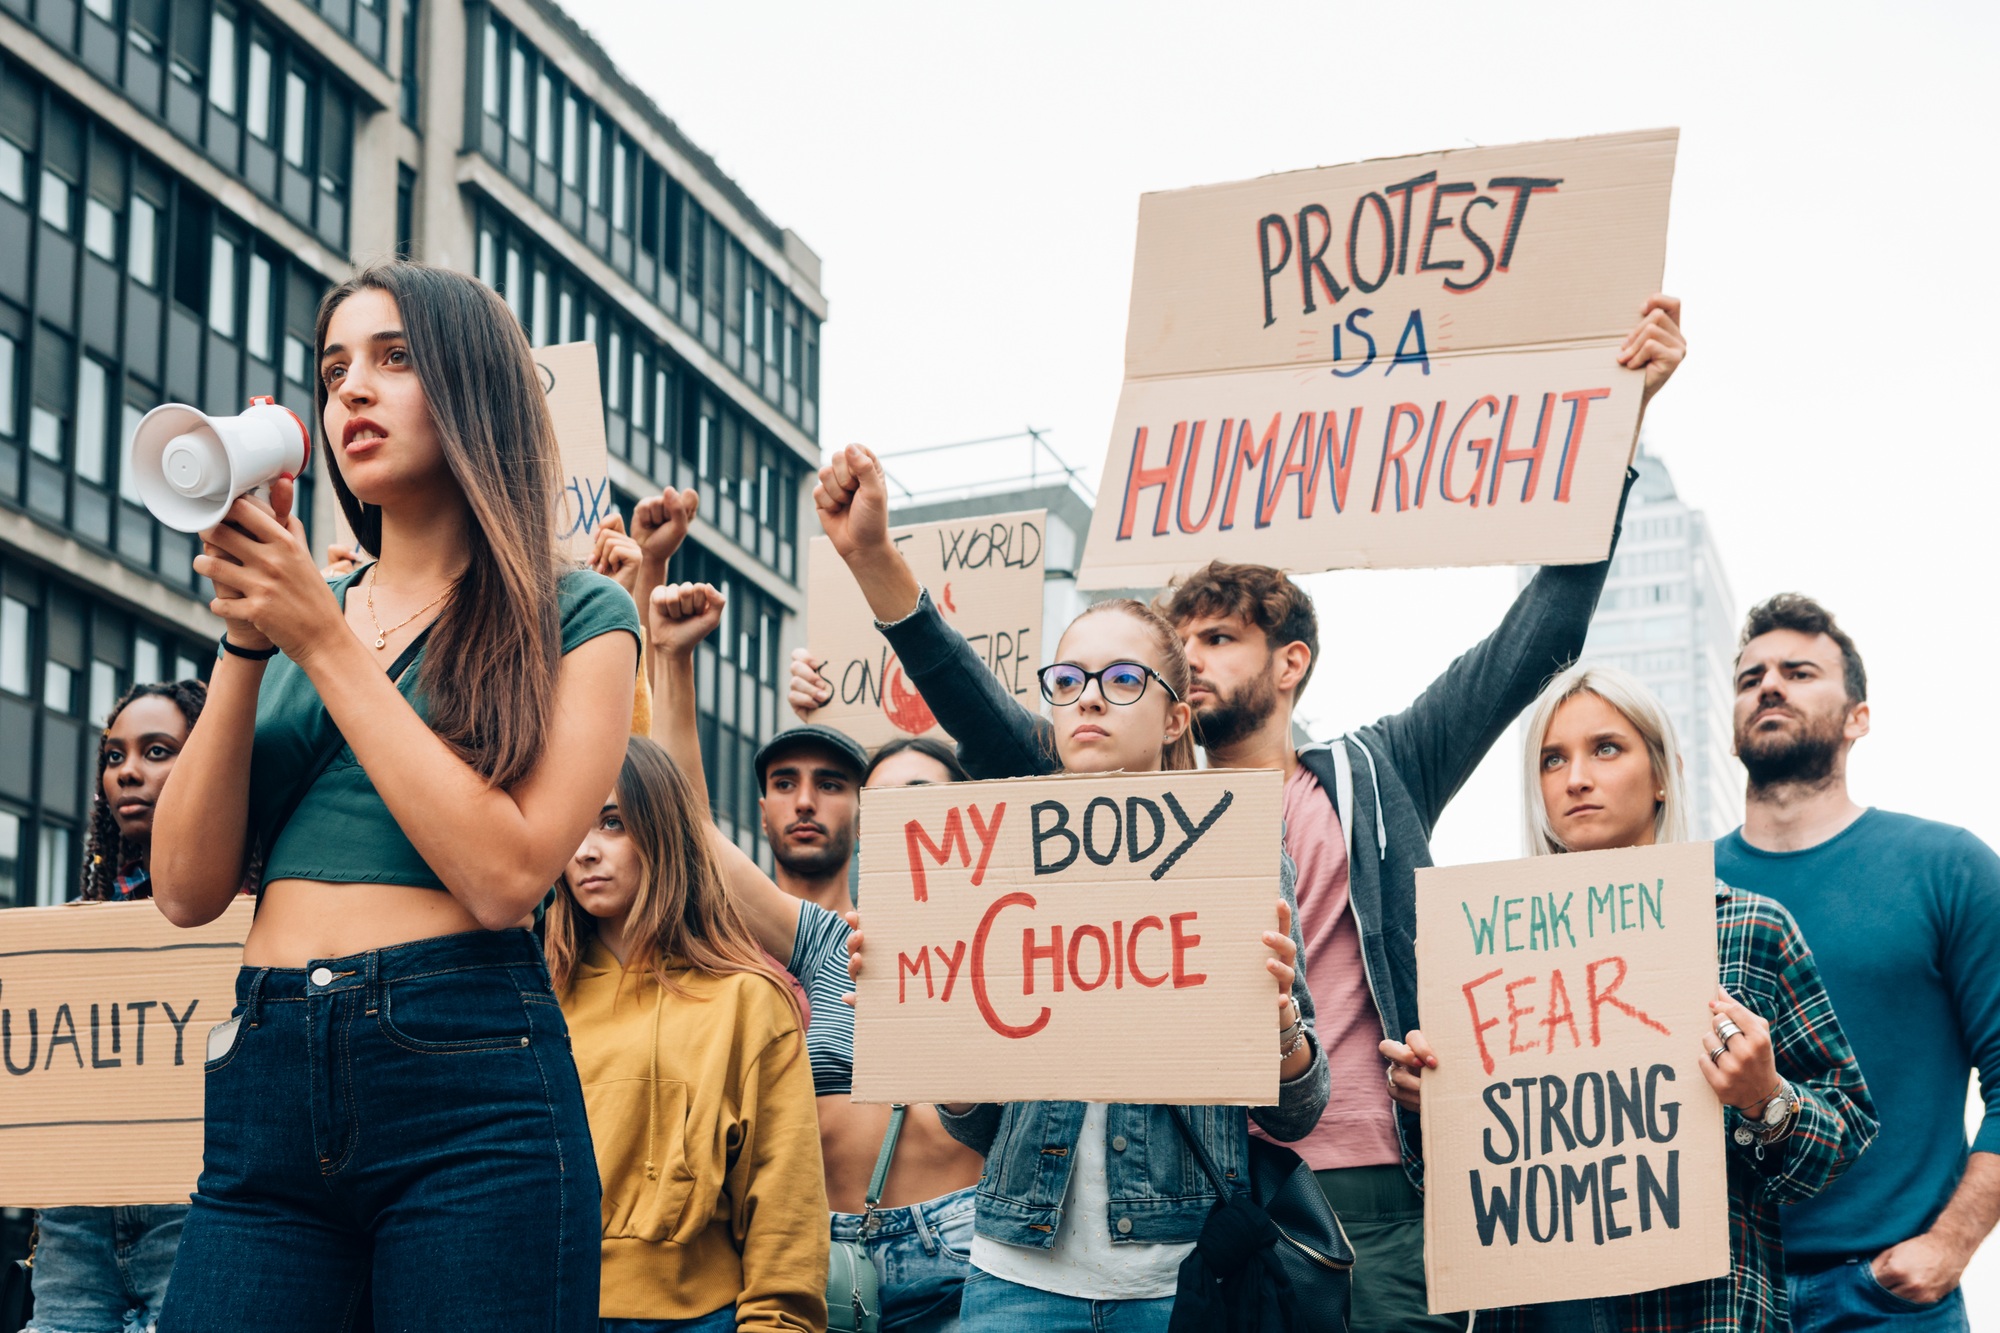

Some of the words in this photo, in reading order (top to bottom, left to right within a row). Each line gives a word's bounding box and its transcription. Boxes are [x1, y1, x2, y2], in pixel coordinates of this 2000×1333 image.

[1257, 171, 1564, 328] PROTEST
[1331, 308, 1377, 377] IS
[1384, 309, 1431, 376] A
[1115, 406, 1363, 541] HUMAN
[1371, 387, 1611, 513] RIGHT
[939, 522, 1041, 571] WORLD
[842, 645, 886, 707] ON
[904, 802, 1007, 902] MY
[1030, 789, 1234, 881] BODY
[898, 940, 966, 1004] MY
[970, 892, 1207, 1039] CHOICE
[1462, 891, 1576, 955] WEAK
[1587, 878, 1665, 938] MEN
[0, 978, 200, 1076] UALITY
[1462, 955, 1671, 1076] FEAR
[1481, 1063, 1683, 1165] STRONG
[1469, 1149, 1682, 1246] WOMEN
